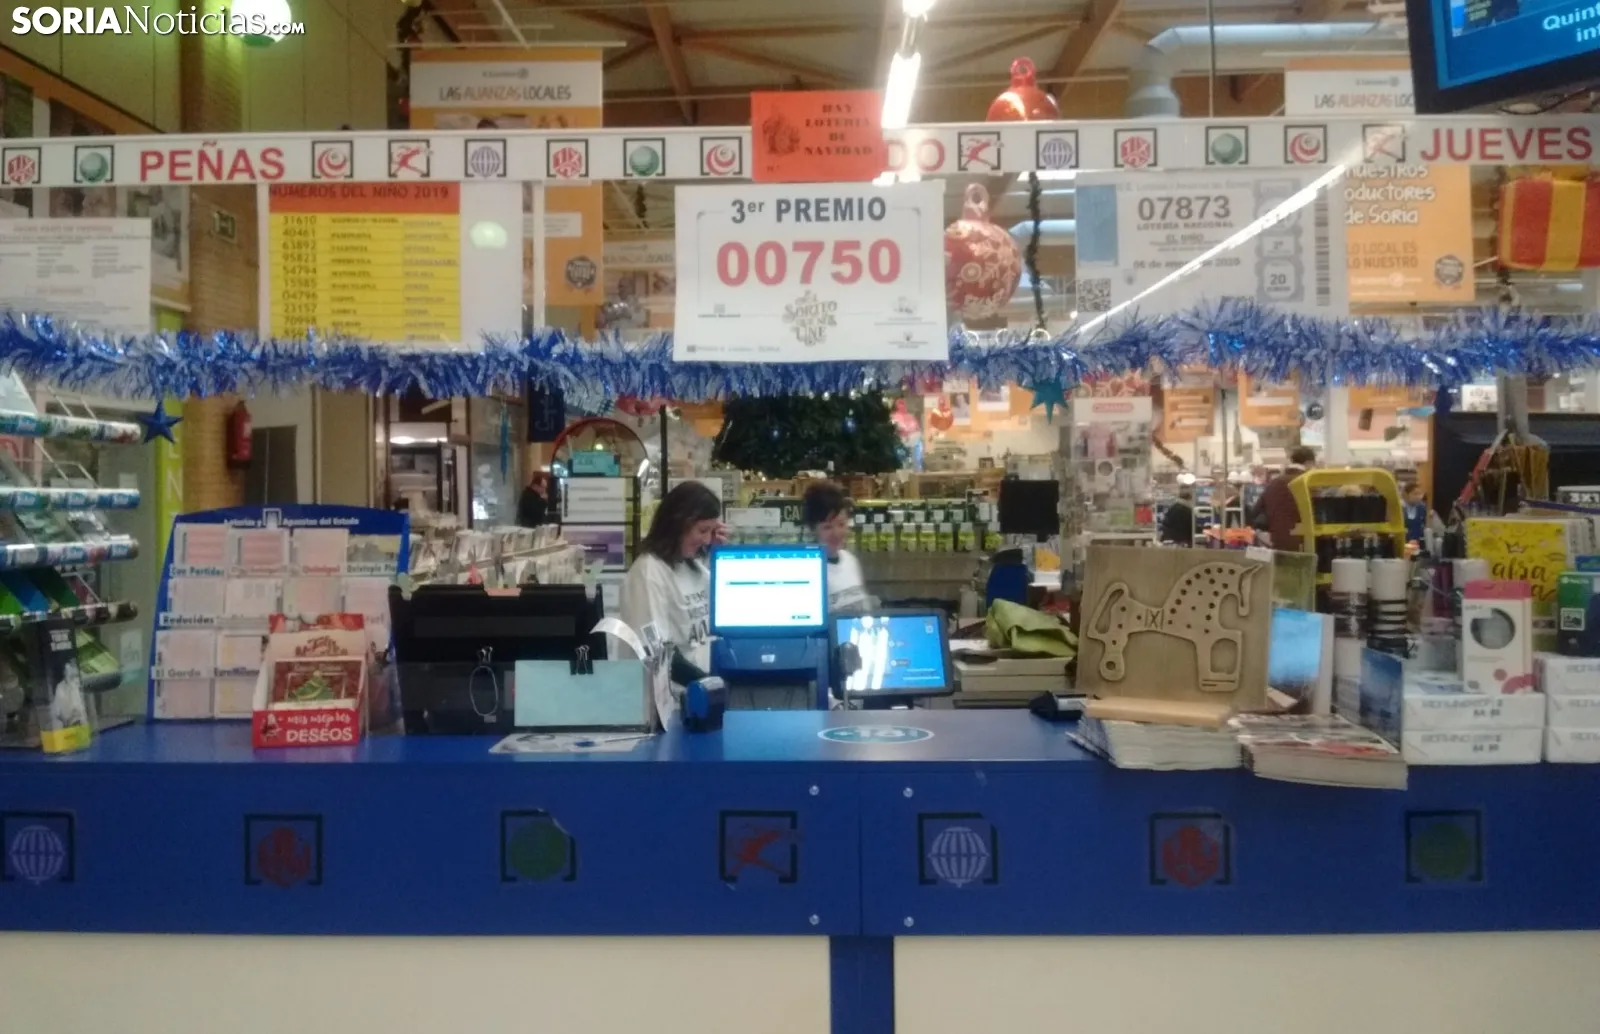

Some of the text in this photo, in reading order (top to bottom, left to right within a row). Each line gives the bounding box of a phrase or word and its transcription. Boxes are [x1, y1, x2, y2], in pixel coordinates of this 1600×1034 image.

[523, 85, 572, 101] LOCALES
[804, 145, 873, 156] NAVIDAD
[1421, 127, 1593, 161] JUEVES
[140, 140, 285, 182] PEÑAS
[341, 185, 366, 199] DEL
[373, 184, 408, 199] NIÑO
[414, 186, 449, 199] 2019
[776, 196, 887, 223] PREMIO
[1138, 195, 1231, 221] 07873
[716, 238, 901, 288] 00750
[1364, 256, 1418, 269] NUESTRO
[1270, 273, 1287, 285] 20
[286, 727, 353, 743] DESEOS
